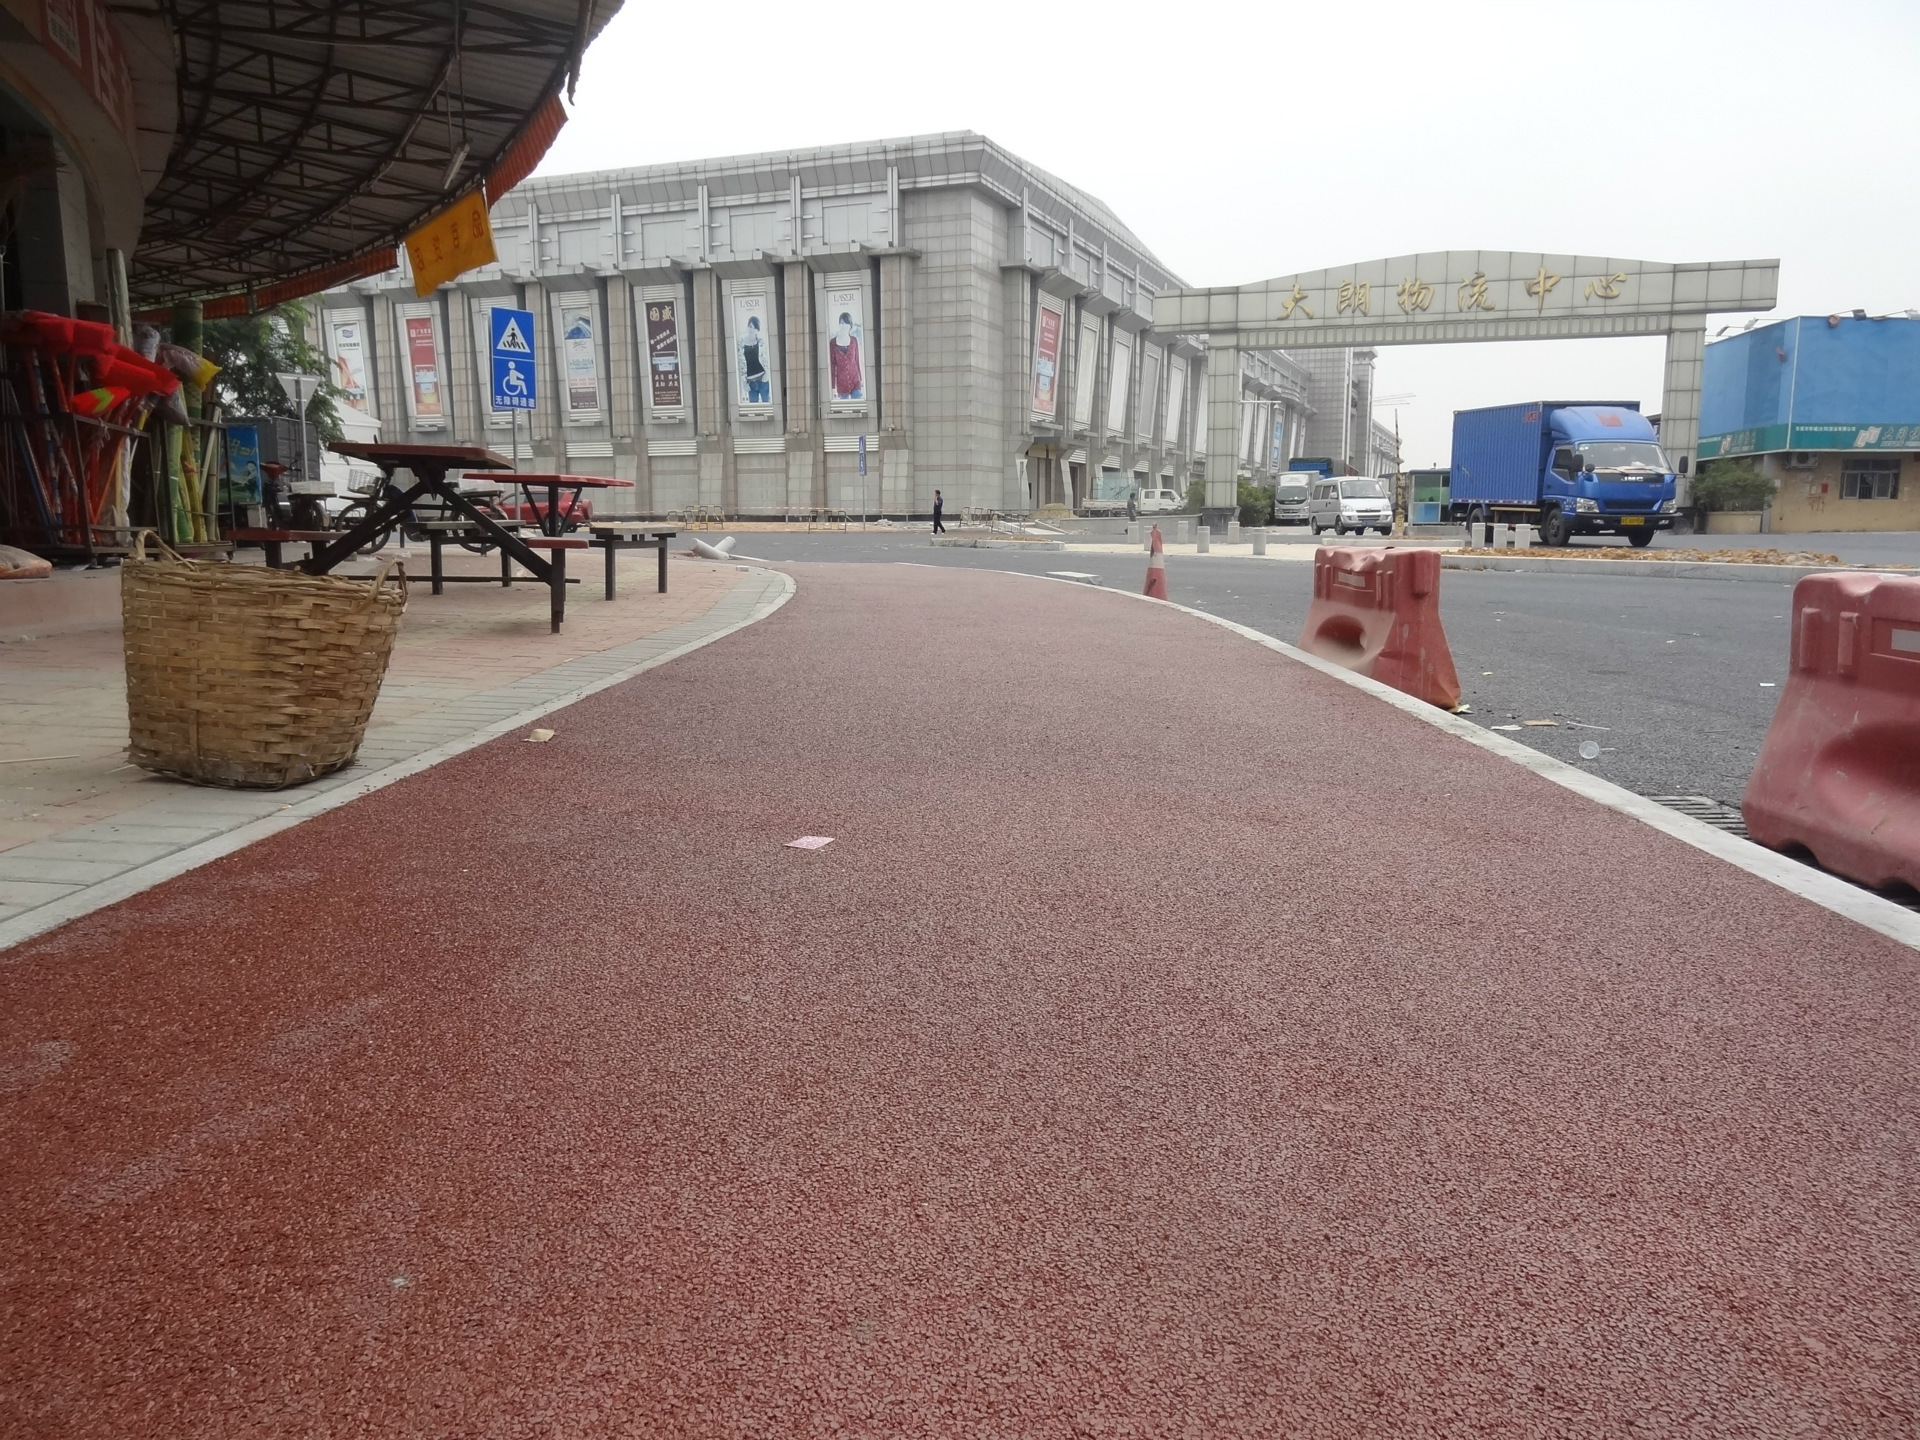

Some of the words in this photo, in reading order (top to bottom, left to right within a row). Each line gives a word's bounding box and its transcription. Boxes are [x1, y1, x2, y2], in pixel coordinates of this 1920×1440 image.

[1276, 267, 1628, 320] 大朗物流中心
[495, 395, 536, 408] 无障碍通道
